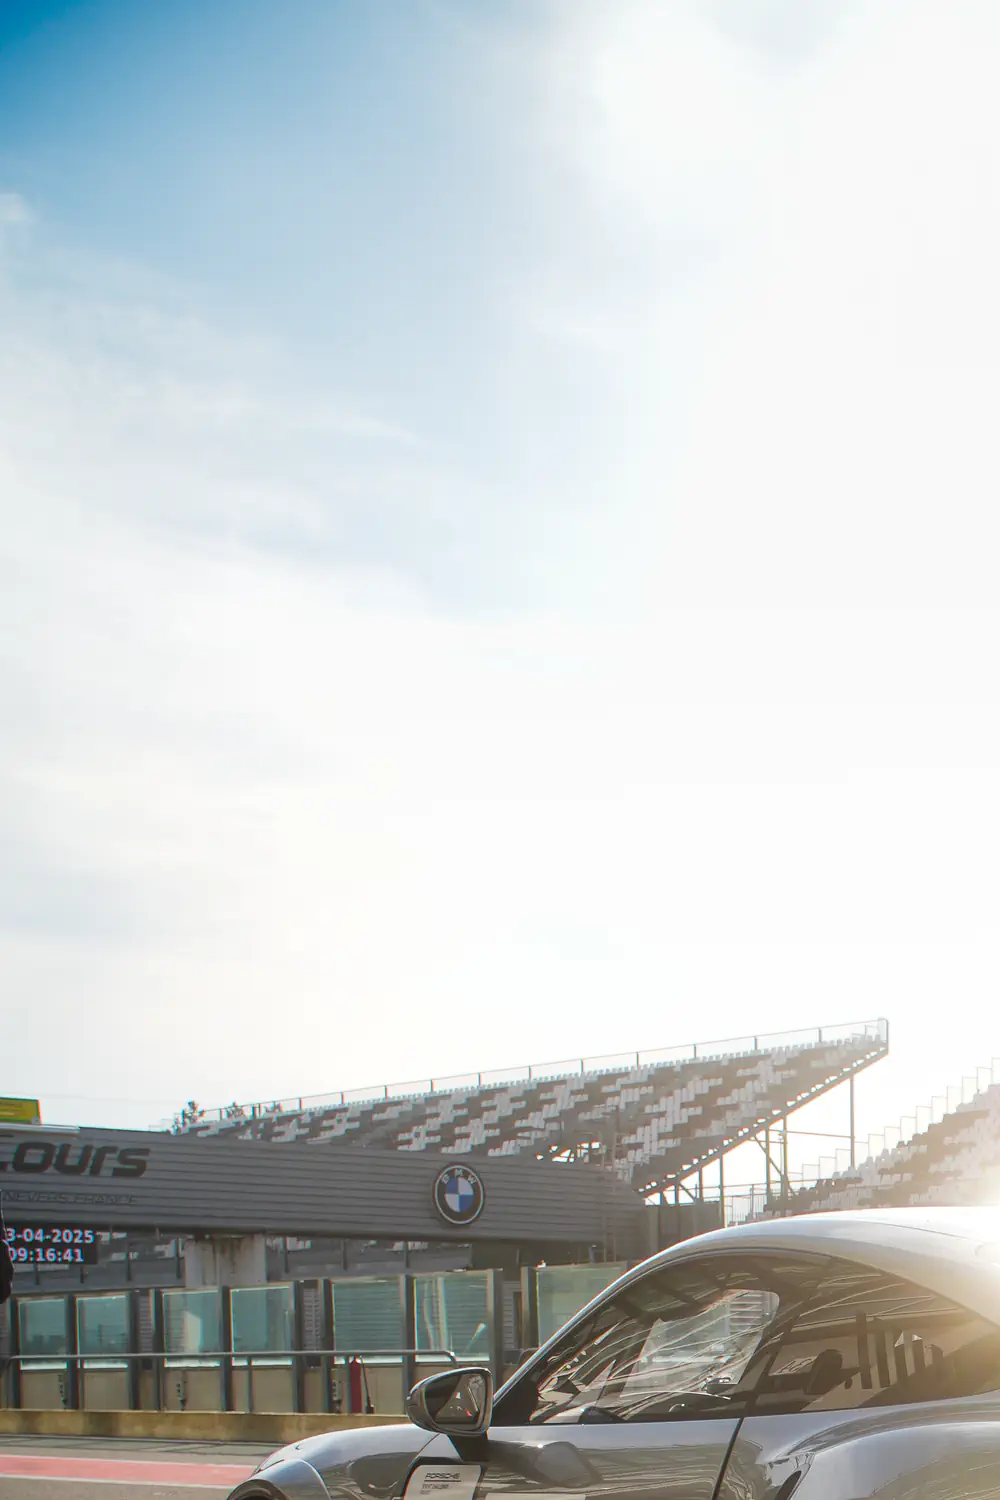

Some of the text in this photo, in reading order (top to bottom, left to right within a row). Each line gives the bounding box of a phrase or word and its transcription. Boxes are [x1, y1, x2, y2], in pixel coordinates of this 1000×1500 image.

[0, 1142, 151, 1177] ours
[441, 1168, 477, 1185] BMW
[7, 1228, 95, 1243] 3-04-2025
